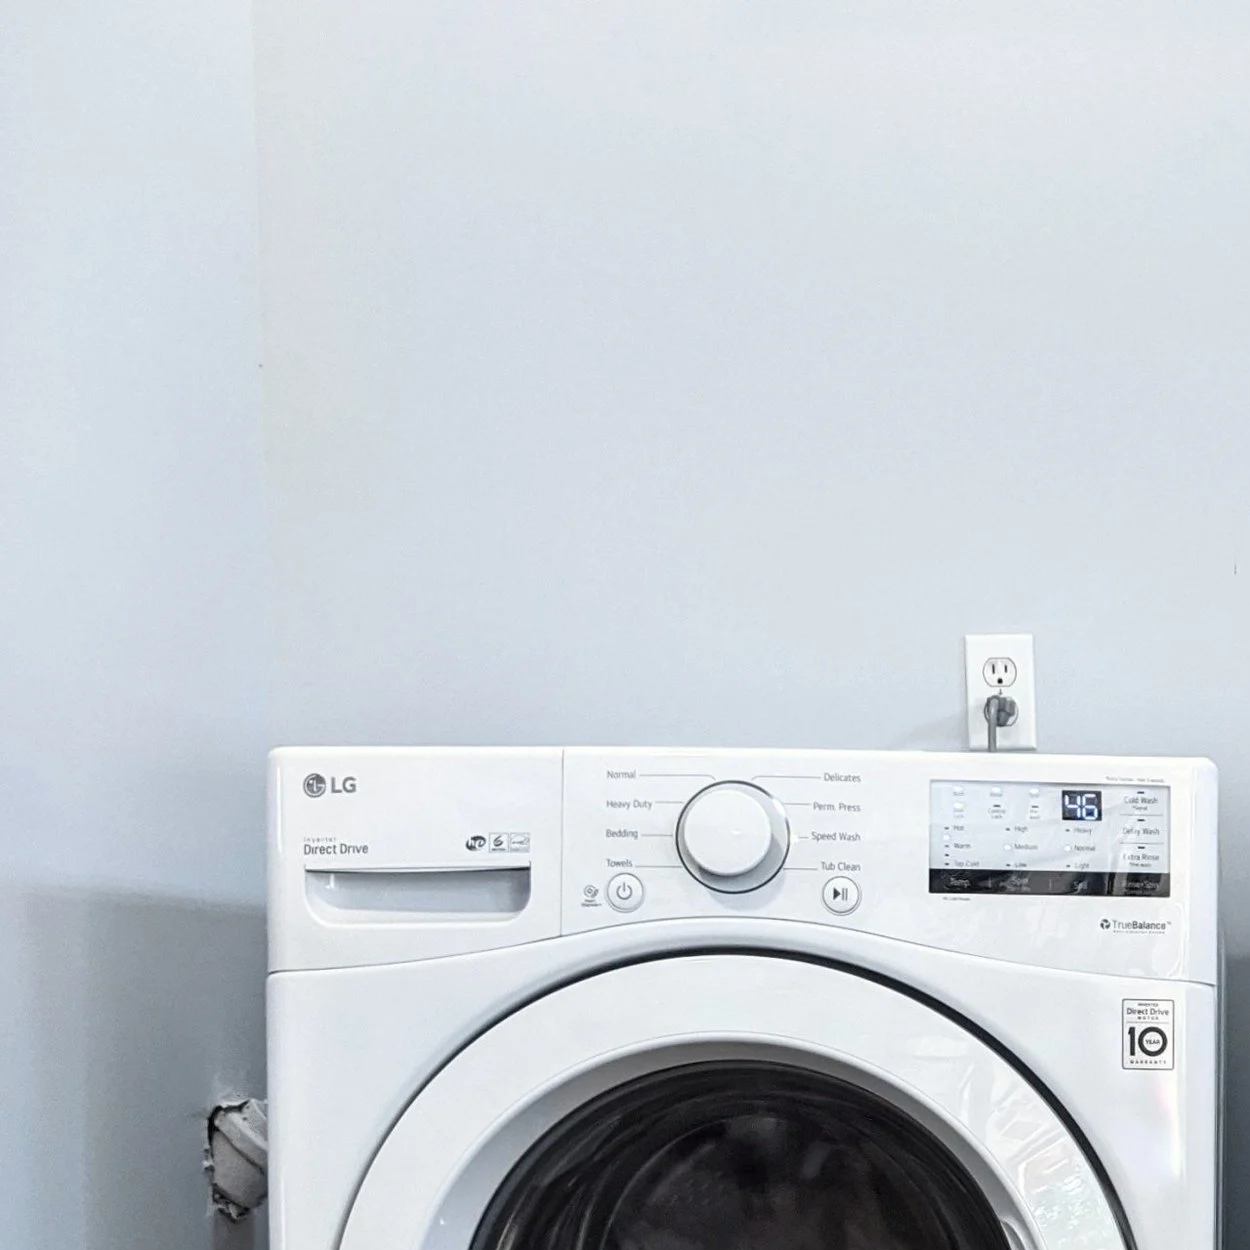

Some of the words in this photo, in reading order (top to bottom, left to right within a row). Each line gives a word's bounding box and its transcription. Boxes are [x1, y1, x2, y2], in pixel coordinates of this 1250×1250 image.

[607, 770, 636, 779] Normal
[823, 773, 861, 782] Delicates
[330, 776, 357, 794] LG
[606, 800, 630, 810] Heavy
[633, 800, 652, 810] Duty
[813, 802, 837, 812] Perm.
[838, 802, 861, 812] Press
[1064, 793, 1098, 820] 46
[606, 829, 638, 840] Bedding
[811, 832, 836, 843] Speed
[839, 832, 861, 841] Wash
[304, 844, 337, 855] Direct
[339, 843, 369, 854] Drive
[606, 858, 633, 868] Towels
[821, 862, 834, 871] Tub
[836, 862, 861, 871] Clean
[1126, 1007, 1148, 1015] Direct
[1150, 1008, 1169, 1016] Drive
[1128, 1026, 1168, 1057] 10
